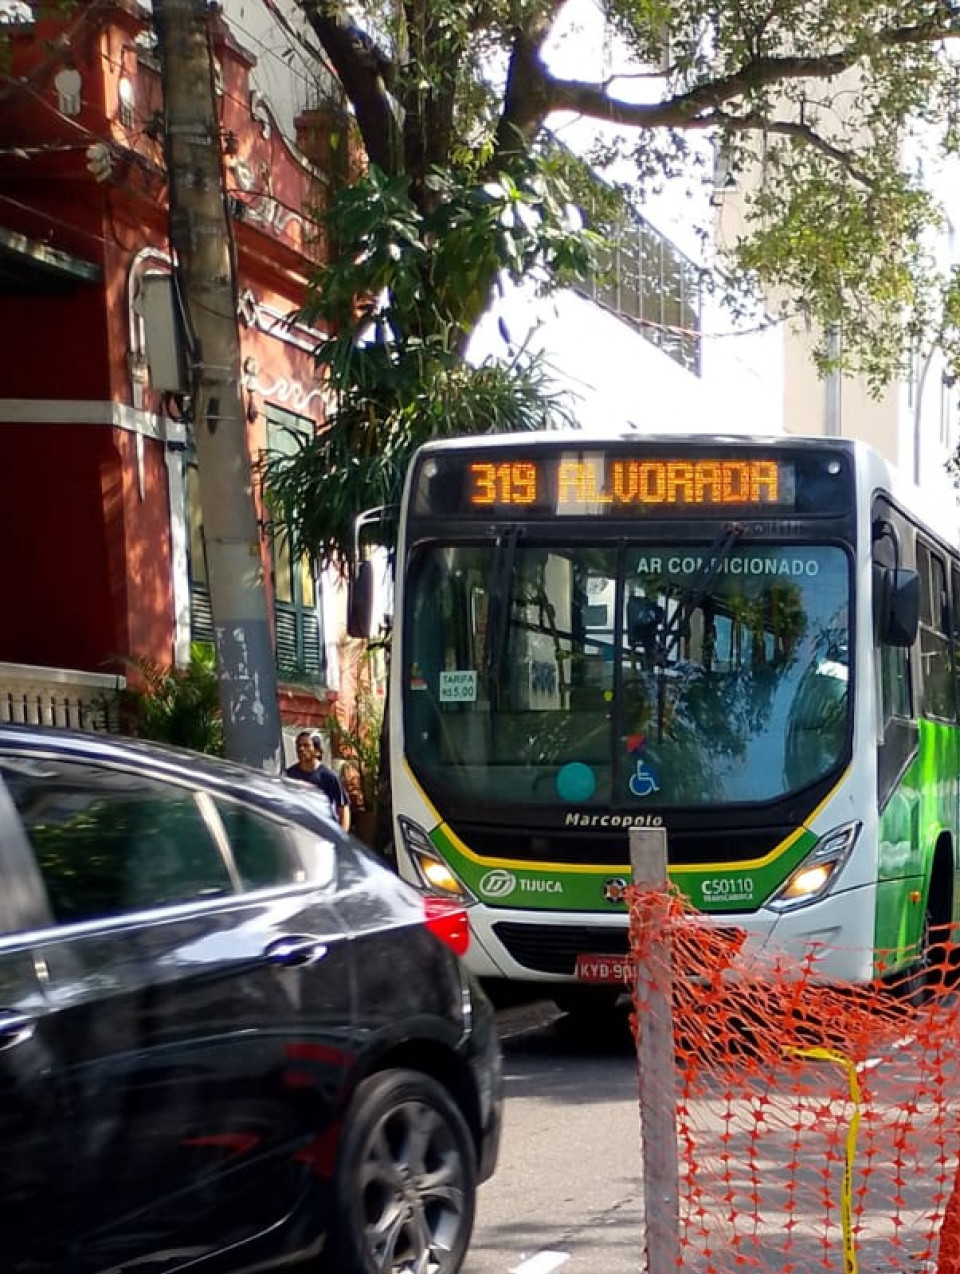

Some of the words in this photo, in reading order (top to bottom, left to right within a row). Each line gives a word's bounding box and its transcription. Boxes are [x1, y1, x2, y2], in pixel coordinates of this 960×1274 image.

[470, 462, 537, 504] 319
[558, 460, 778, 504] ALVORADA
[637, 557, 662, 573] AR
[443, 674, 474, 683] TARIFA
[565, 813, 664, 828] Marcopolo
[520, 879, 563, 893] TIJUCA
[701, 878, 753, 895] C50110
